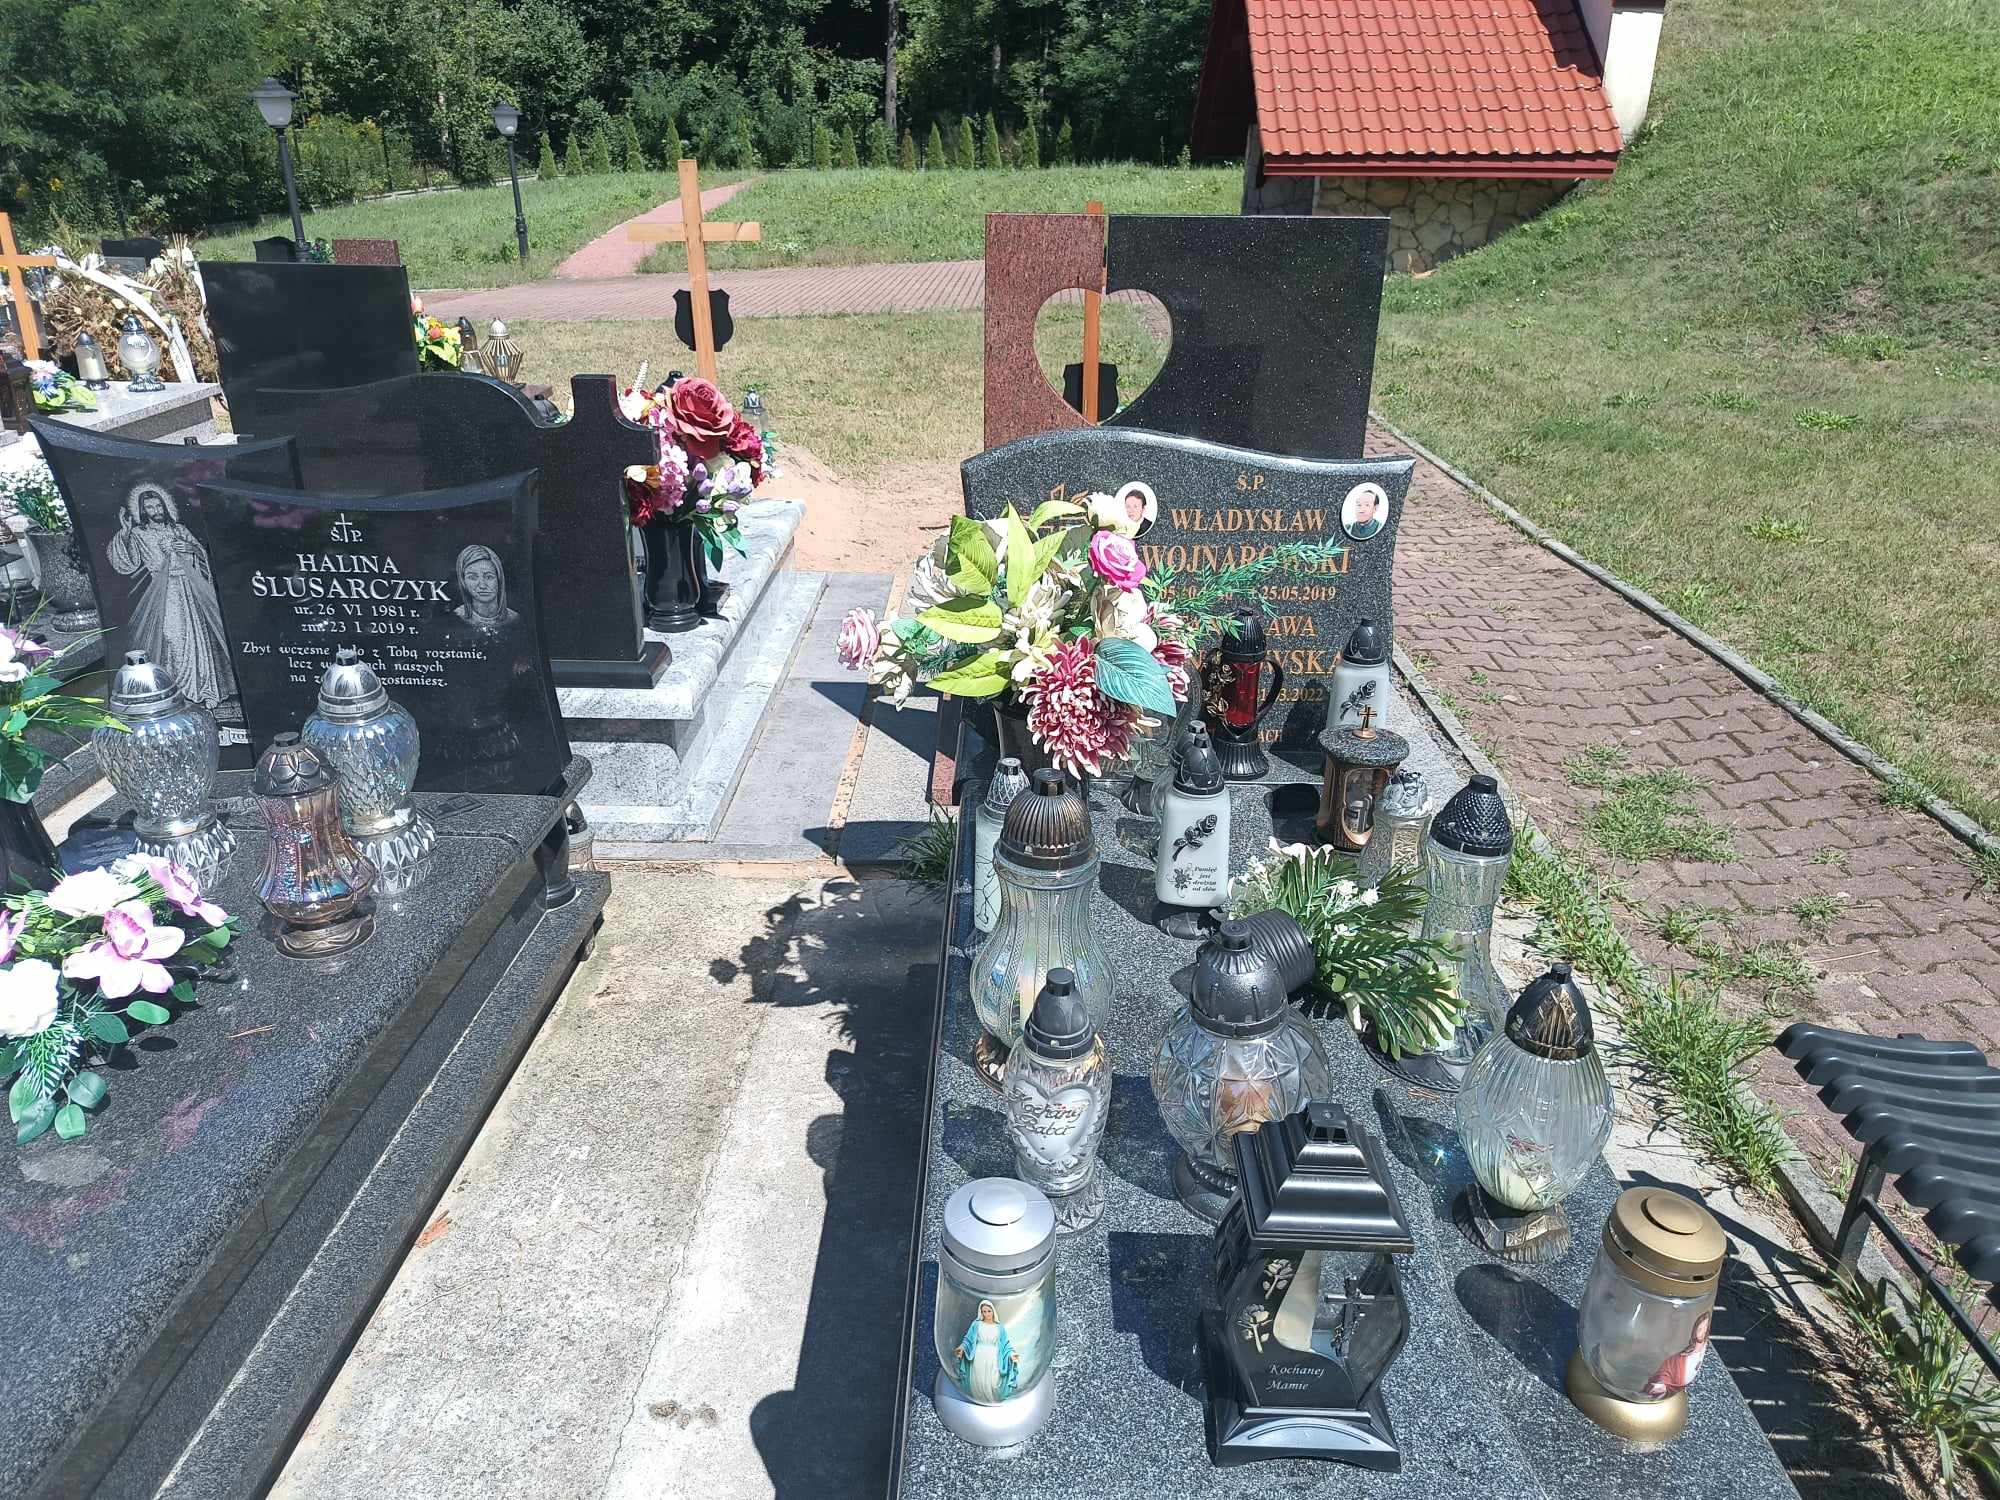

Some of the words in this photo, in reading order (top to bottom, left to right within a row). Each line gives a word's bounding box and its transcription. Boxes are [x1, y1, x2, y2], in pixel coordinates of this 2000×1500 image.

[1171, 507, 1328, 533] WŁADYSŁAW
[296, 553, 401, 575] HALINA
[252, 569, 451, 602] ŚLUSARCZYK
[294, 605, 313, 615] ur.
[318, 603, 336, 616] 26
[342, 603, 363, 617] VI
[372, 605, 406, 618] 1981
[330, 621, 347, 633] 23
[370, 621, 405, 635] 2019
[241, 641, 272, 656] Zbyt
[278, 646, 331, 657] wczesne
[371, 649, 380, 659] z
[386, 645, 419, 660] Tobą
[425, 648, 487, 661] rozstanie,
[287, 656, 313, 670] lecz
[394, 660, 444, 674] naszych
[289, 674, 307, 684] na
[1269, 1363, 1325, 1378] Kochanej
[1265, 1380, 1309, 1390] Mamie
